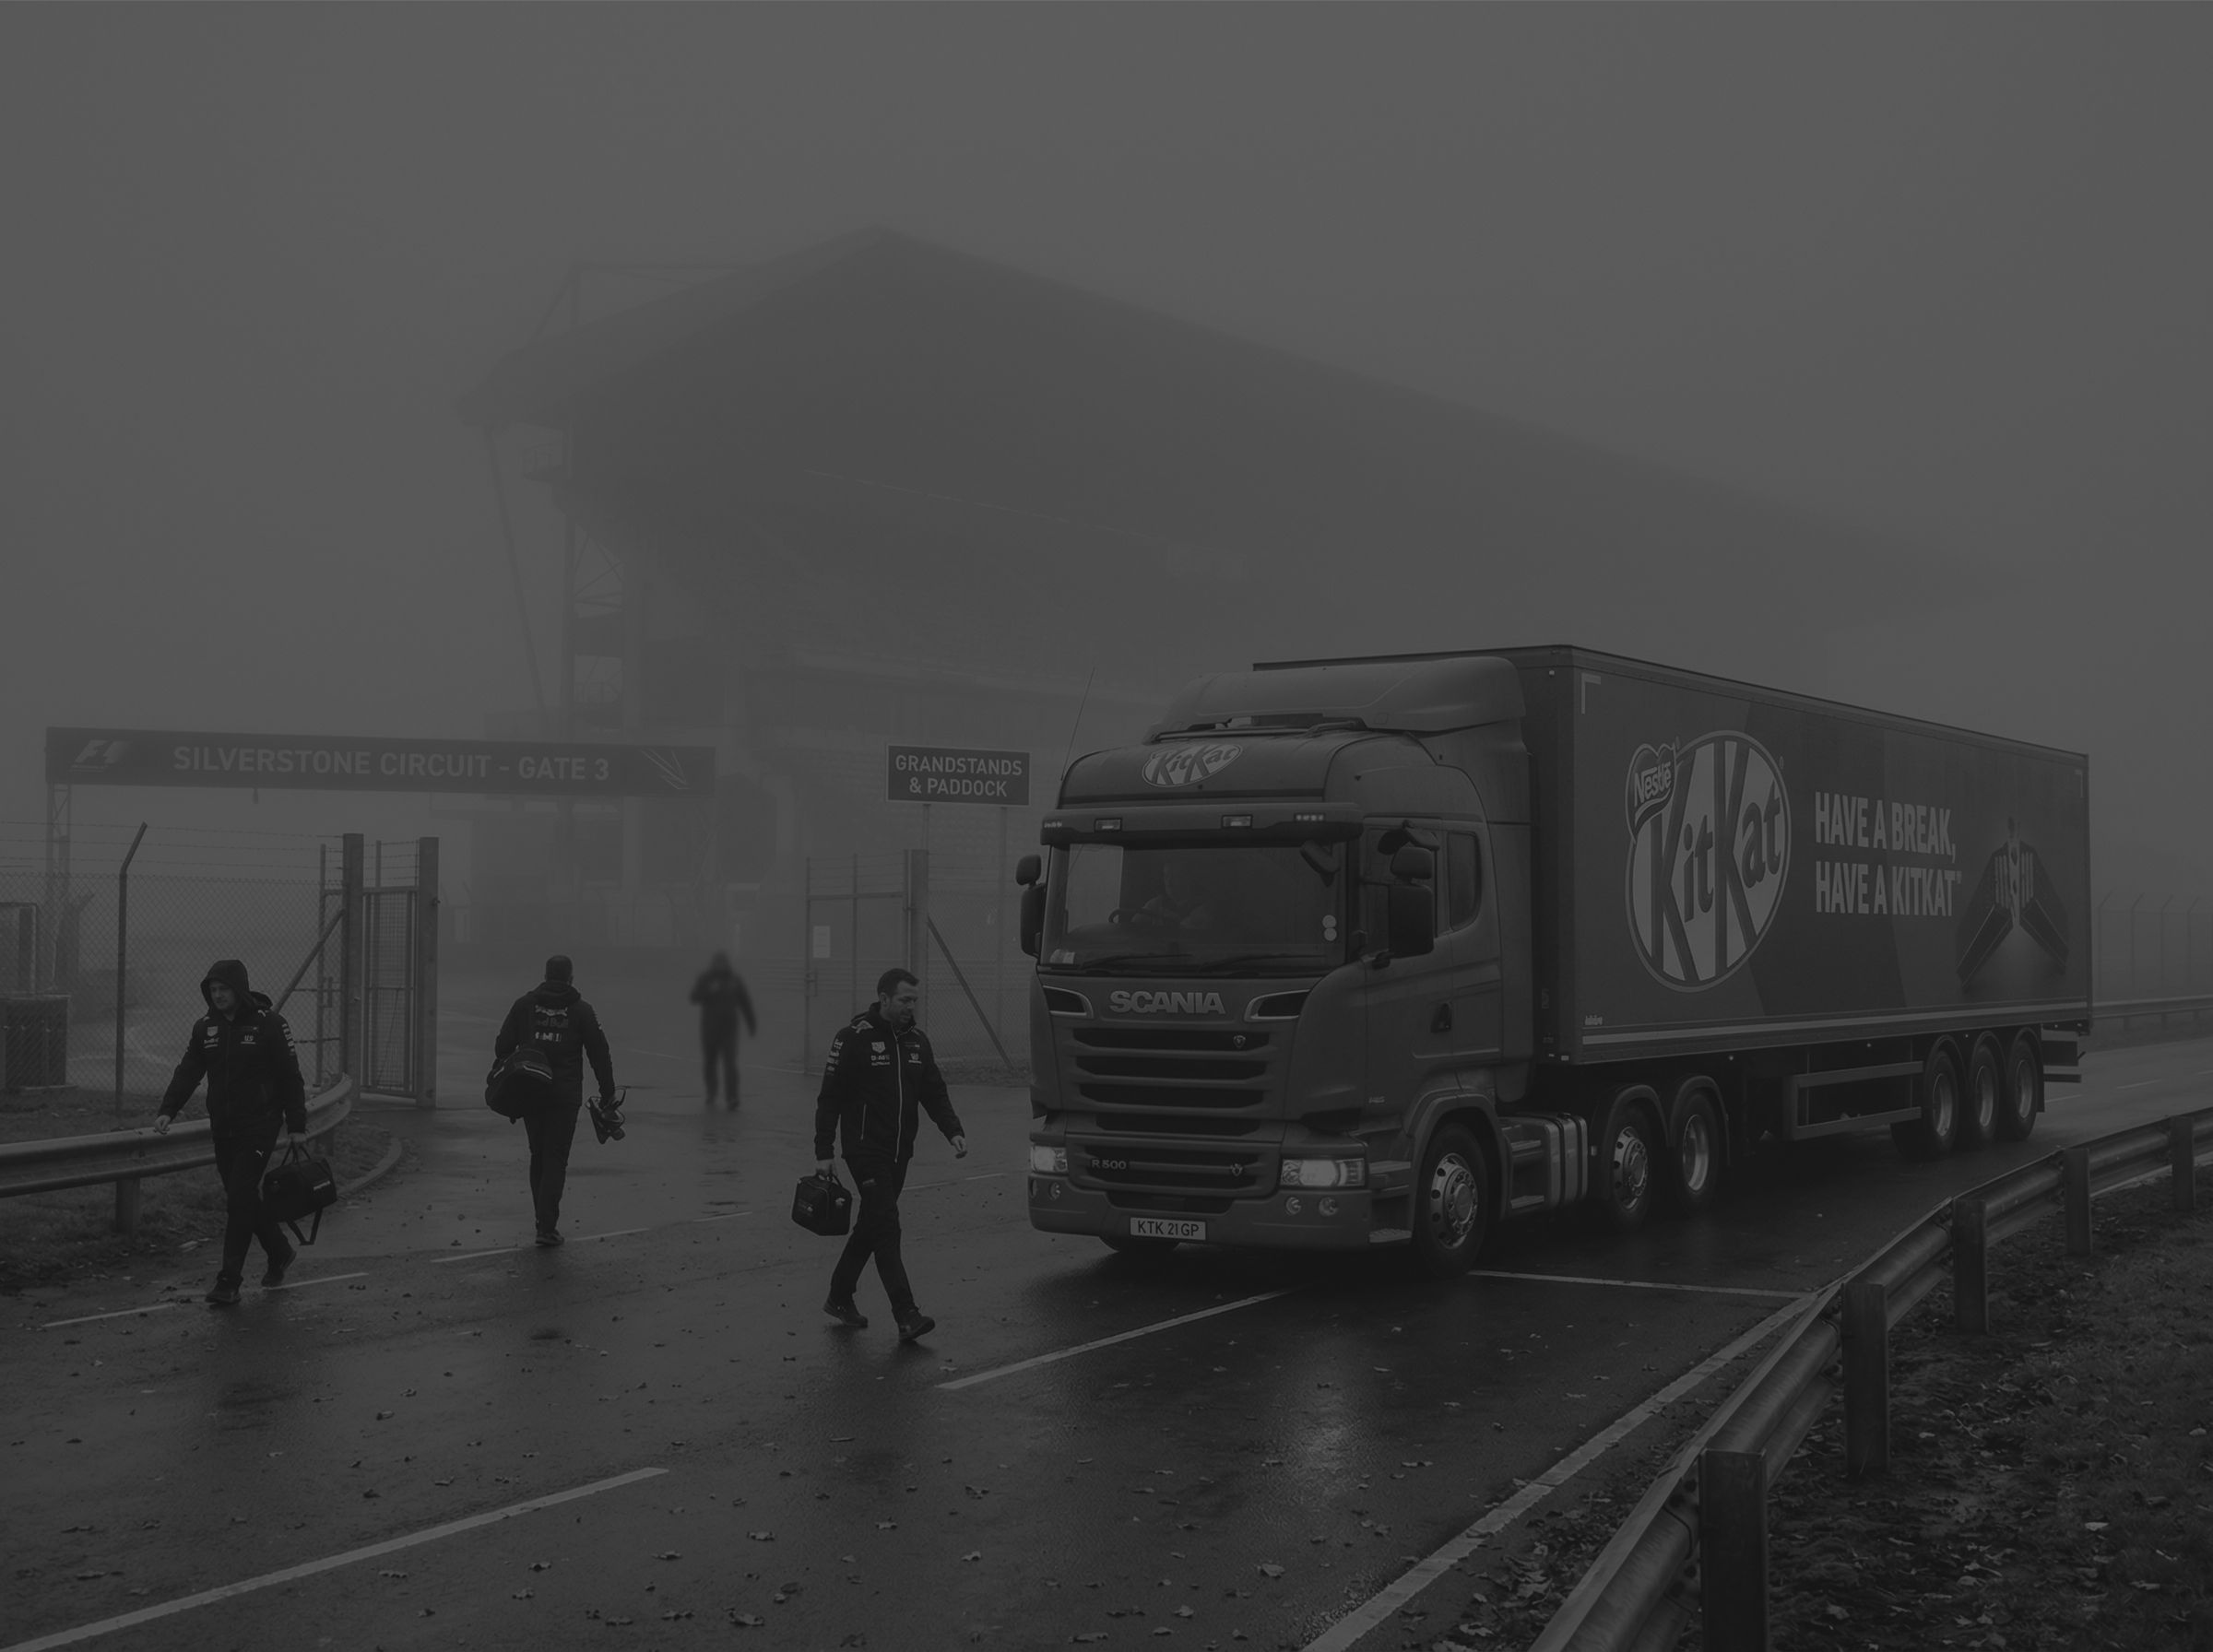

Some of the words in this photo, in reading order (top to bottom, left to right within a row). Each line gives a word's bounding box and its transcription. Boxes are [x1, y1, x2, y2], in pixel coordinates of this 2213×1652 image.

[172, 746, 372, 774] SILVERSTONE
[380, 751, 491, 778] CIRCUIT
[518, 756, 586, 781] GATE
[594, 758, 609, 781] 3
[895, 754, 1023, 775] GRANDSTANDS
[909, 776, 922, 794] &
[927, 777, 1008, 797] PADDOCK
[1815, 791, 1870, 848] HAVE
[1873, 798, 1888, 850] A
[1891, 801, 1957, 864] BREAK,
[1651, 738, 1782, 983] KitKat
[1815, 860, 1870, 914] HAVE
[1873, 864, 1888, 915] A
[1108, 989, 1226, 1015] SCANIA
[1101, 1159, 1128, 1170] 500
[1137, 1220, 1164, 1235] KTK
